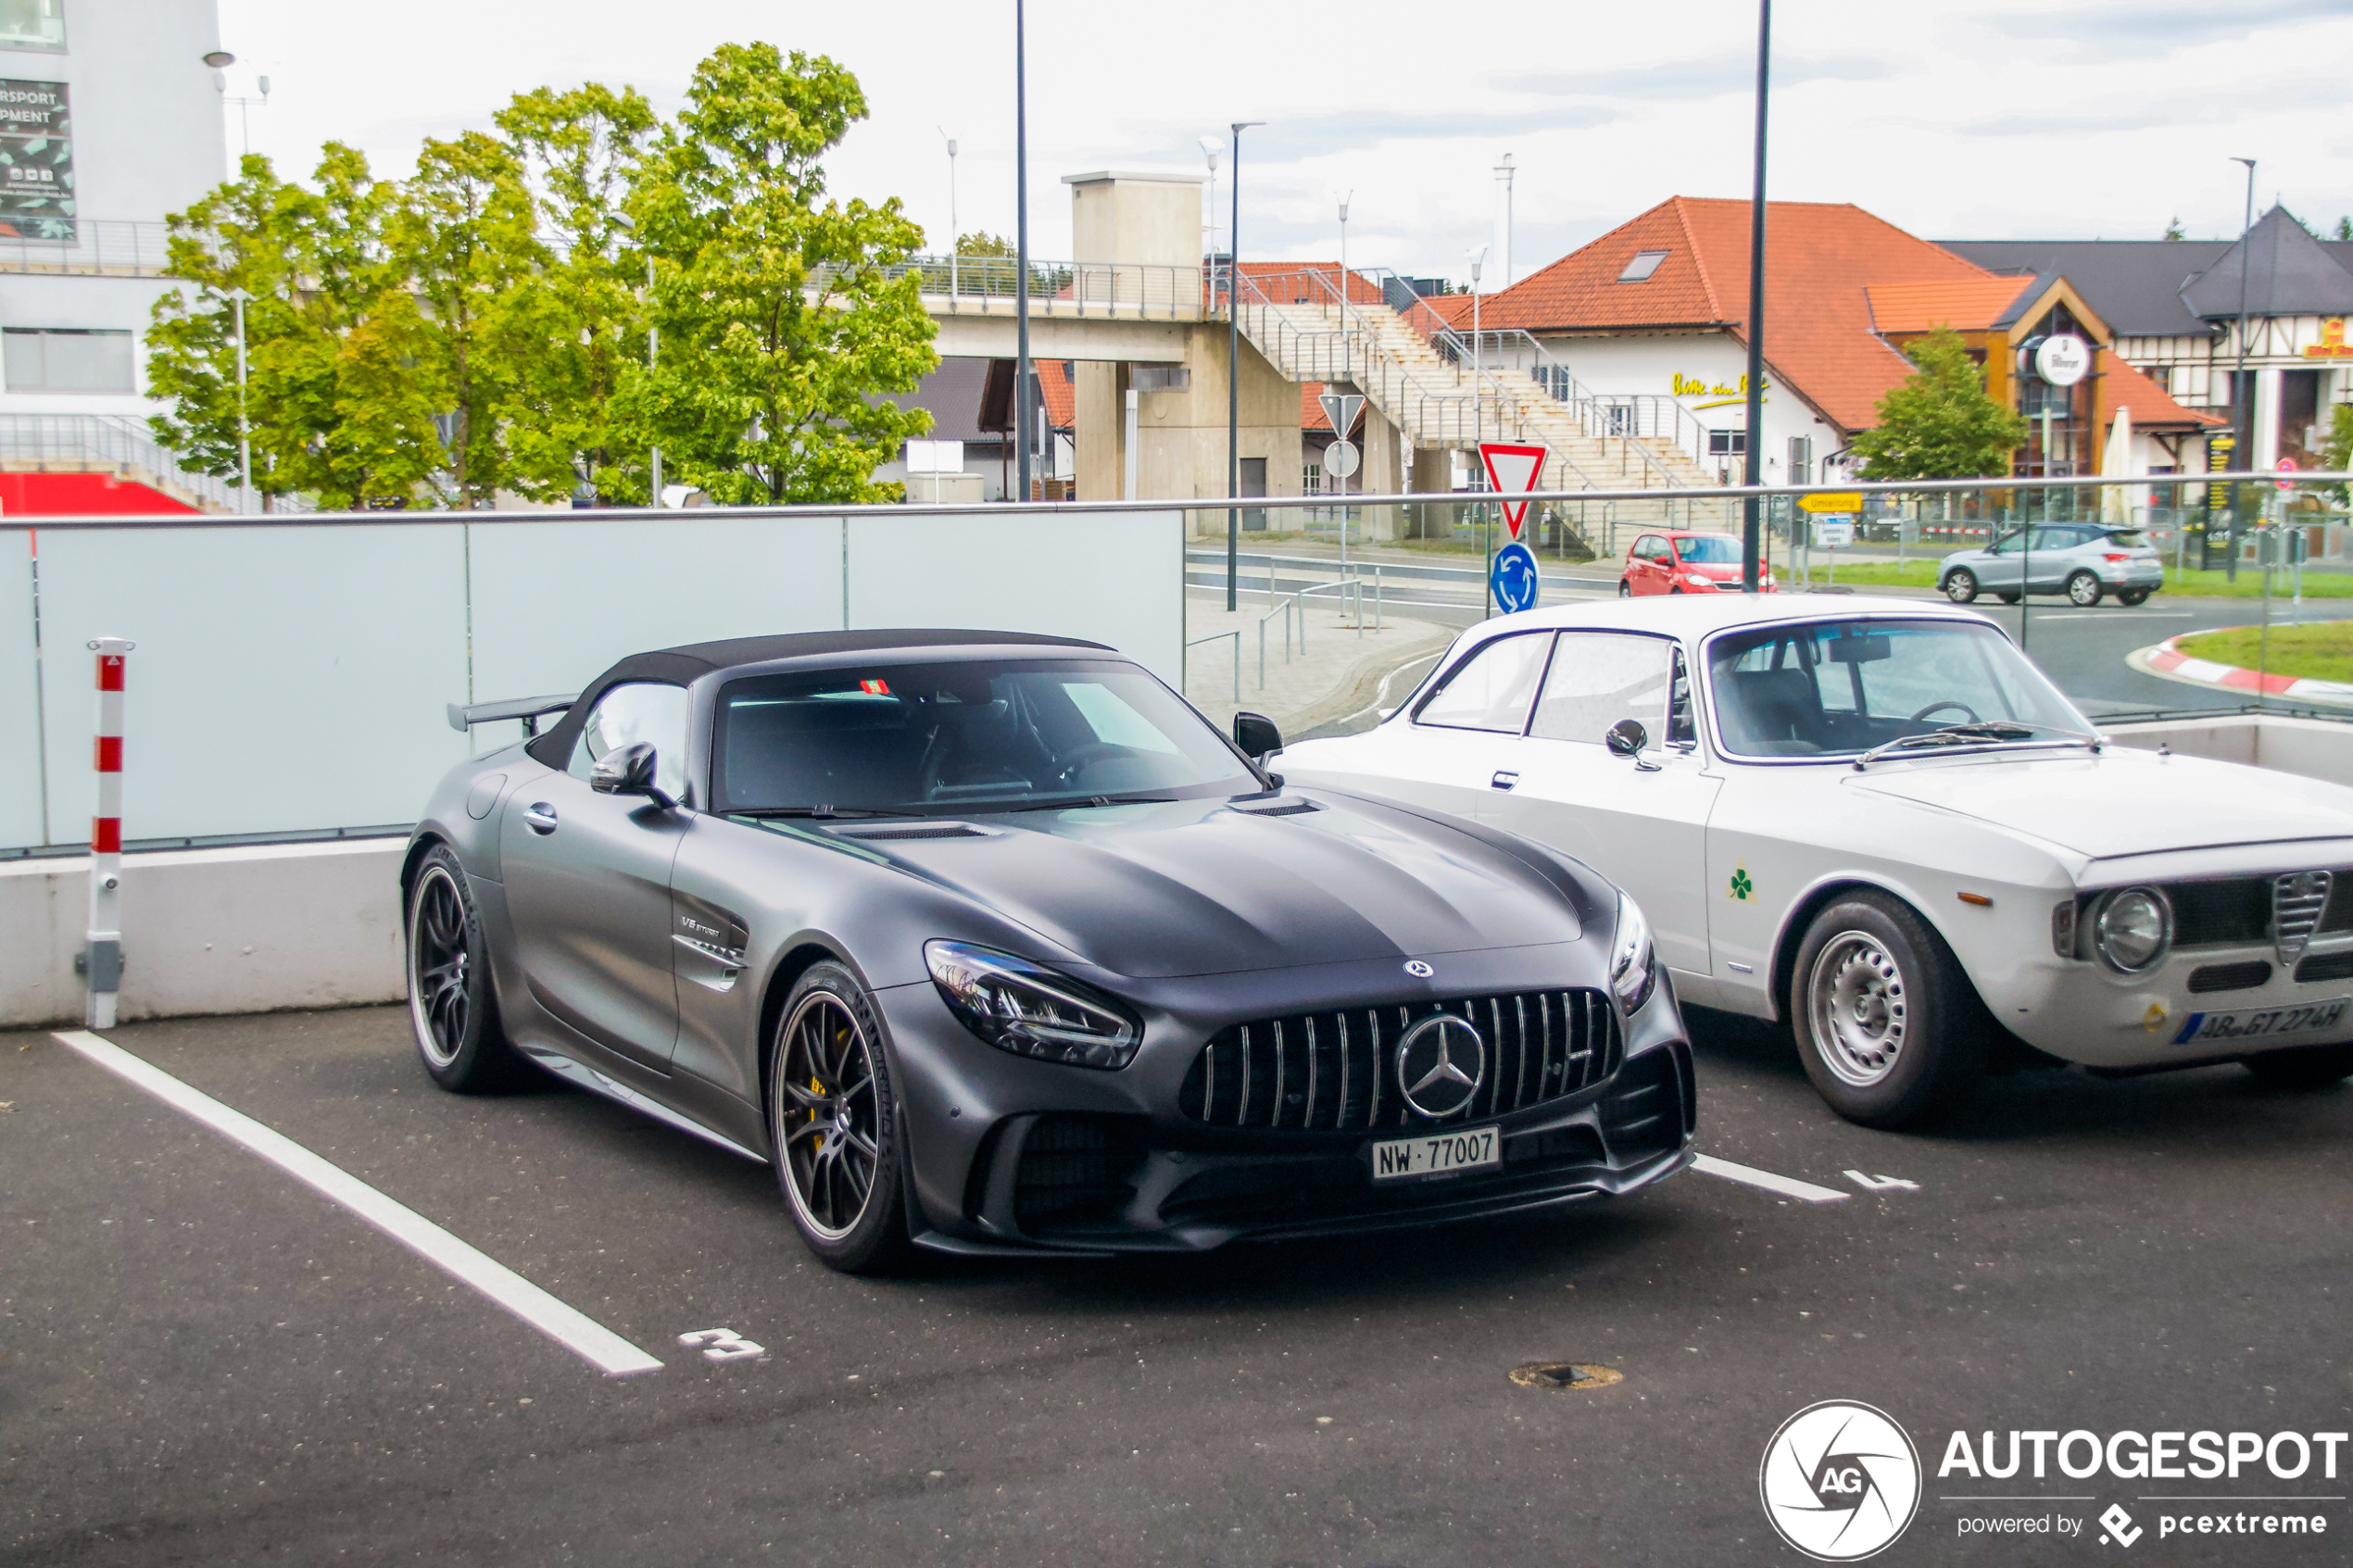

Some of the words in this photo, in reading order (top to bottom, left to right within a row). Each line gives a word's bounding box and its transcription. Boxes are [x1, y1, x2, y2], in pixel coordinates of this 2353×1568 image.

[1672, 371, 1706, 395] Bitte
[1711, 382, 1735, 395] ein
[1811, 498, 1855, 508] Umleitung
[2199, 1015, 2235, 1038] AB
[2245, 1011, 2283, 1035] GT
[1427, 1132, 1493, 1170] 77007
[1842, 1168, 1921, 1193] 4
[677, 1326, 766, 1362] 3
